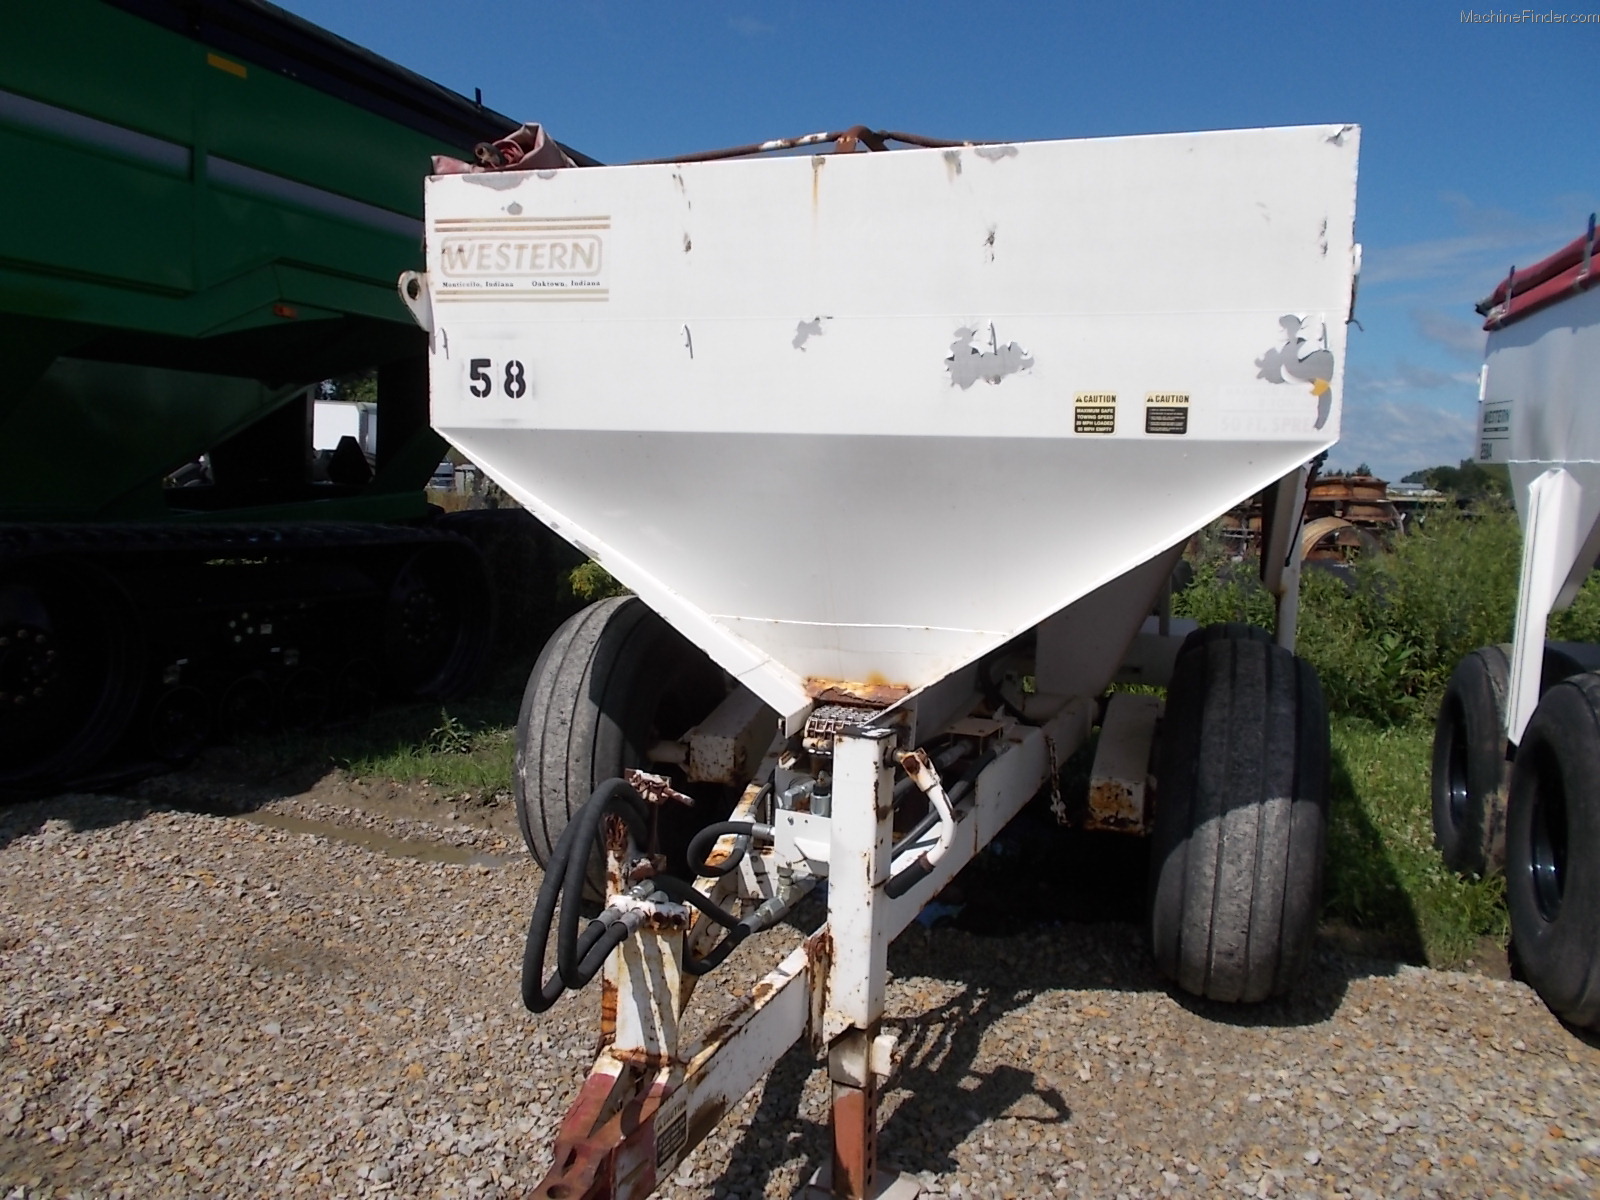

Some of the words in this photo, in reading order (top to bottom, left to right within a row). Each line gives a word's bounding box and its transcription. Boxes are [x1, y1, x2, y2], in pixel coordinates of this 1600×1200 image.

[444, 241, 595, 271] WESTERN
[1083, 394, 1117, 403] CAUTION
[1155, 394, 1190, 403] CAUTION
